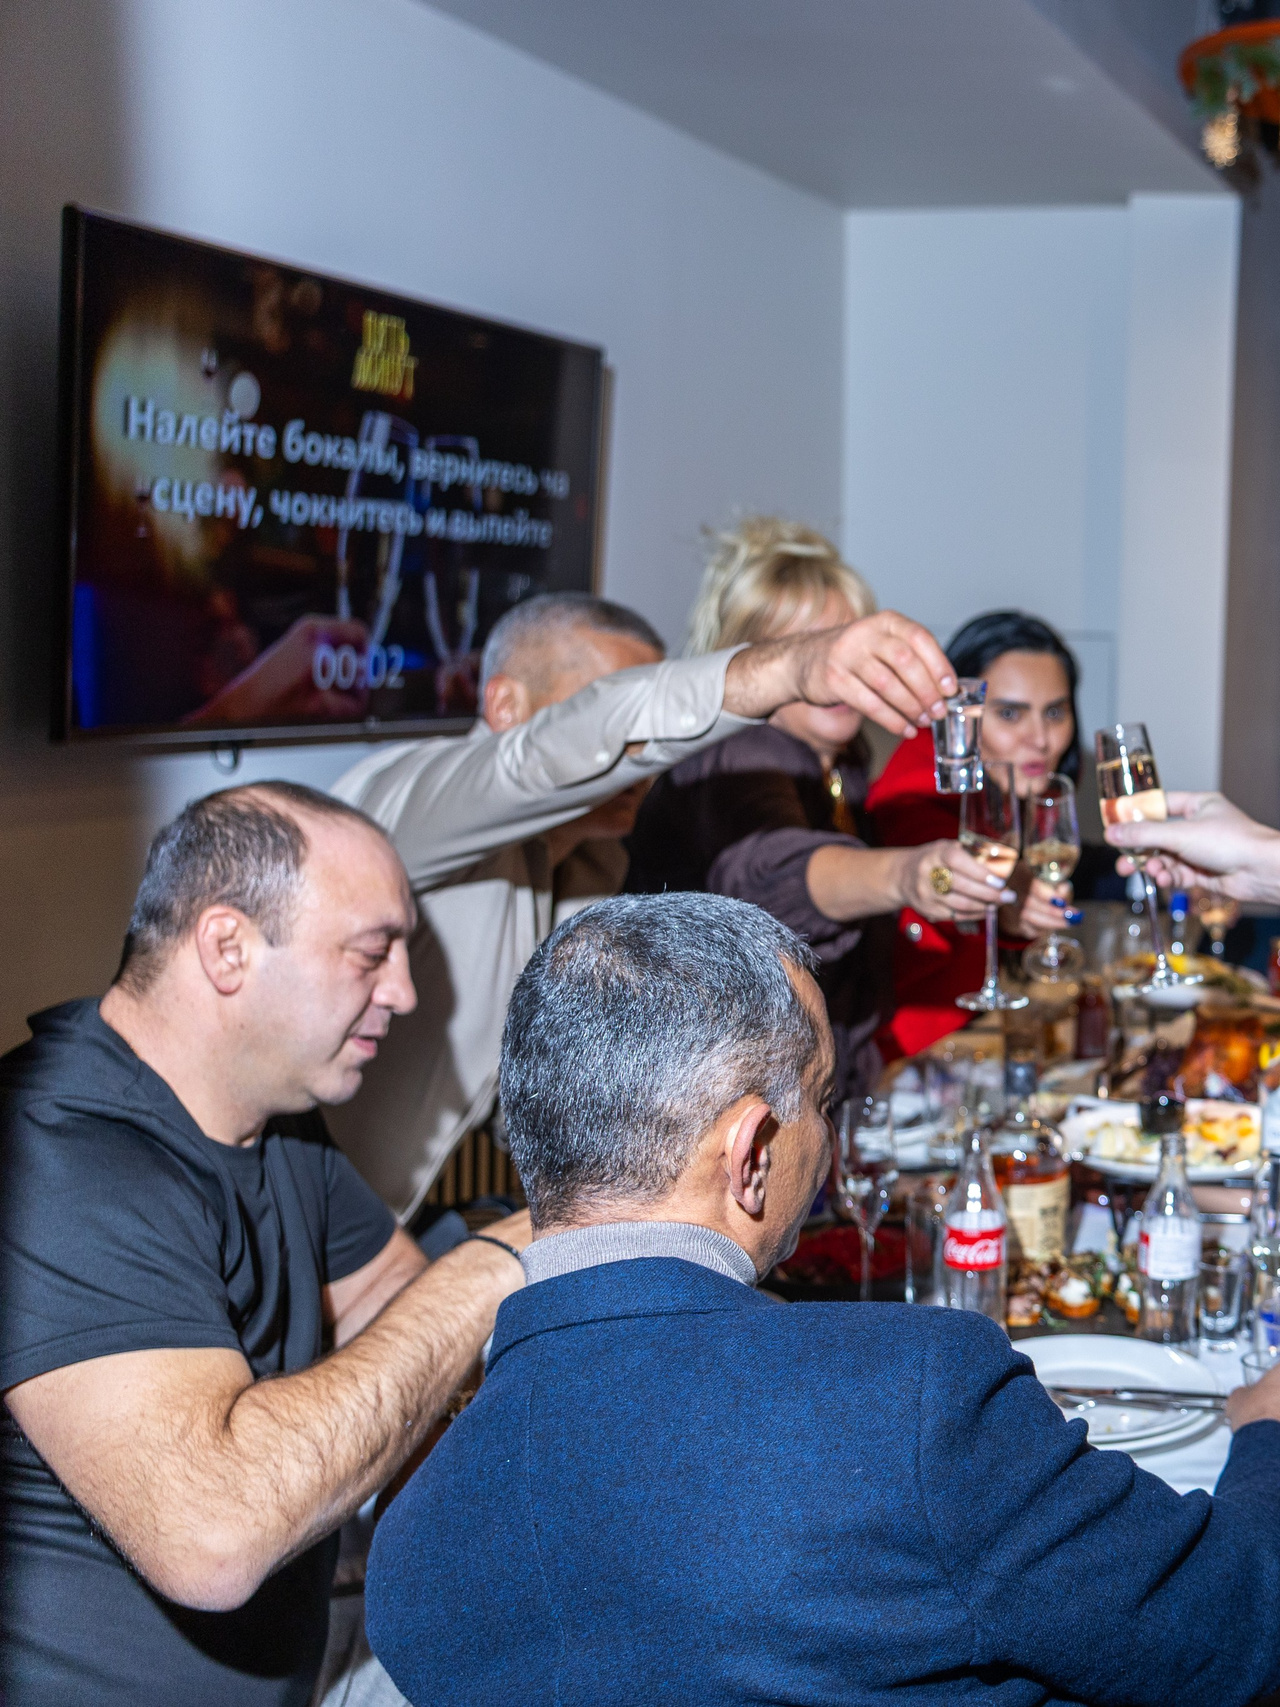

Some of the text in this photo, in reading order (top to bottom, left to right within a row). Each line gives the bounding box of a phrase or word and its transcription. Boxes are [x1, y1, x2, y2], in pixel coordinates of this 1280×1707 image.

[128, 396, 278, 460] Налейте
[281, 418, 405, 484] бокалы,
[410, 448, 540, 497] вернитесь
[152, 477, 553, 549] сцену, чокнитесь и выпейте
[312, 643, 405, 691] 00:02
